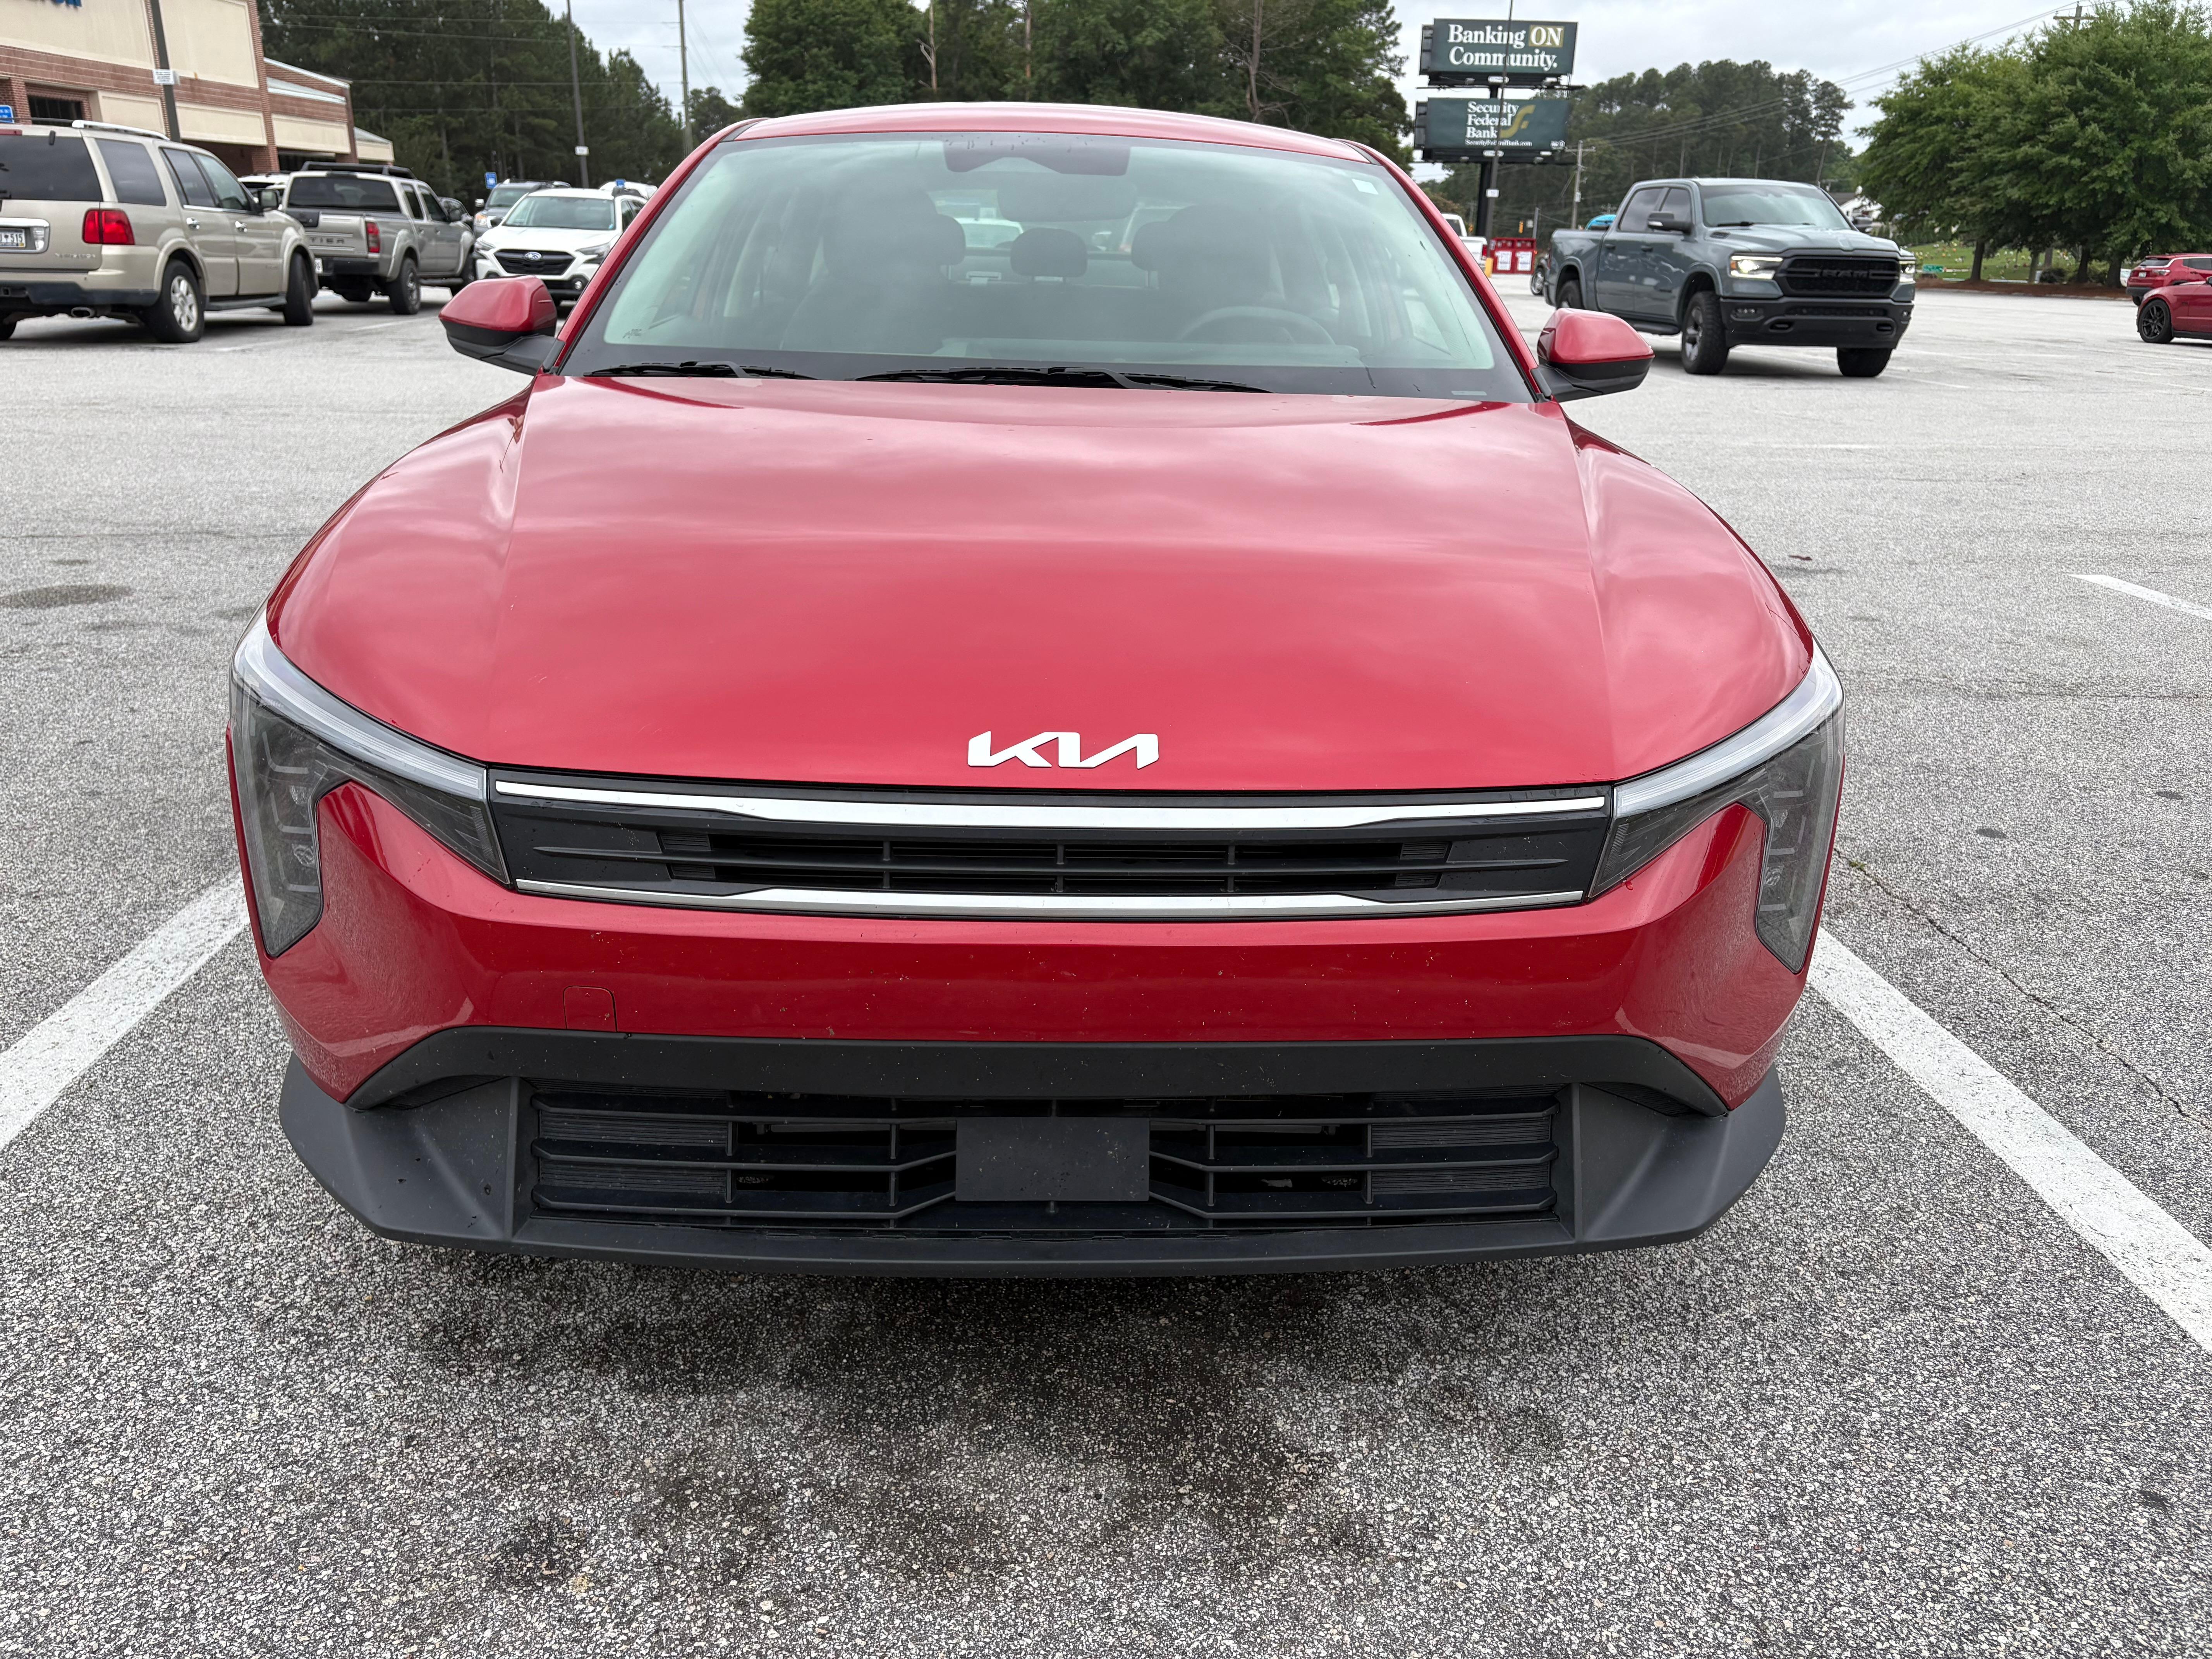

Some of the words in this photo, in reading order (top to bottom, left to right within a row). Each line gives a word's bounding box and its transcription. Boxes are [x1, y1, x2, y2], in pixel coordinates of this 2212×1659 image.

[1448, 24, 1527, 49] Banking
[1530, 26, 1563, 46] ON
[1449, 46, 1558, 71] Community.
[1465, 126, 1498, 138] Bank
[1467, 113, 1512, 126] Federal
[968, 730, 1159, 770] KIA
